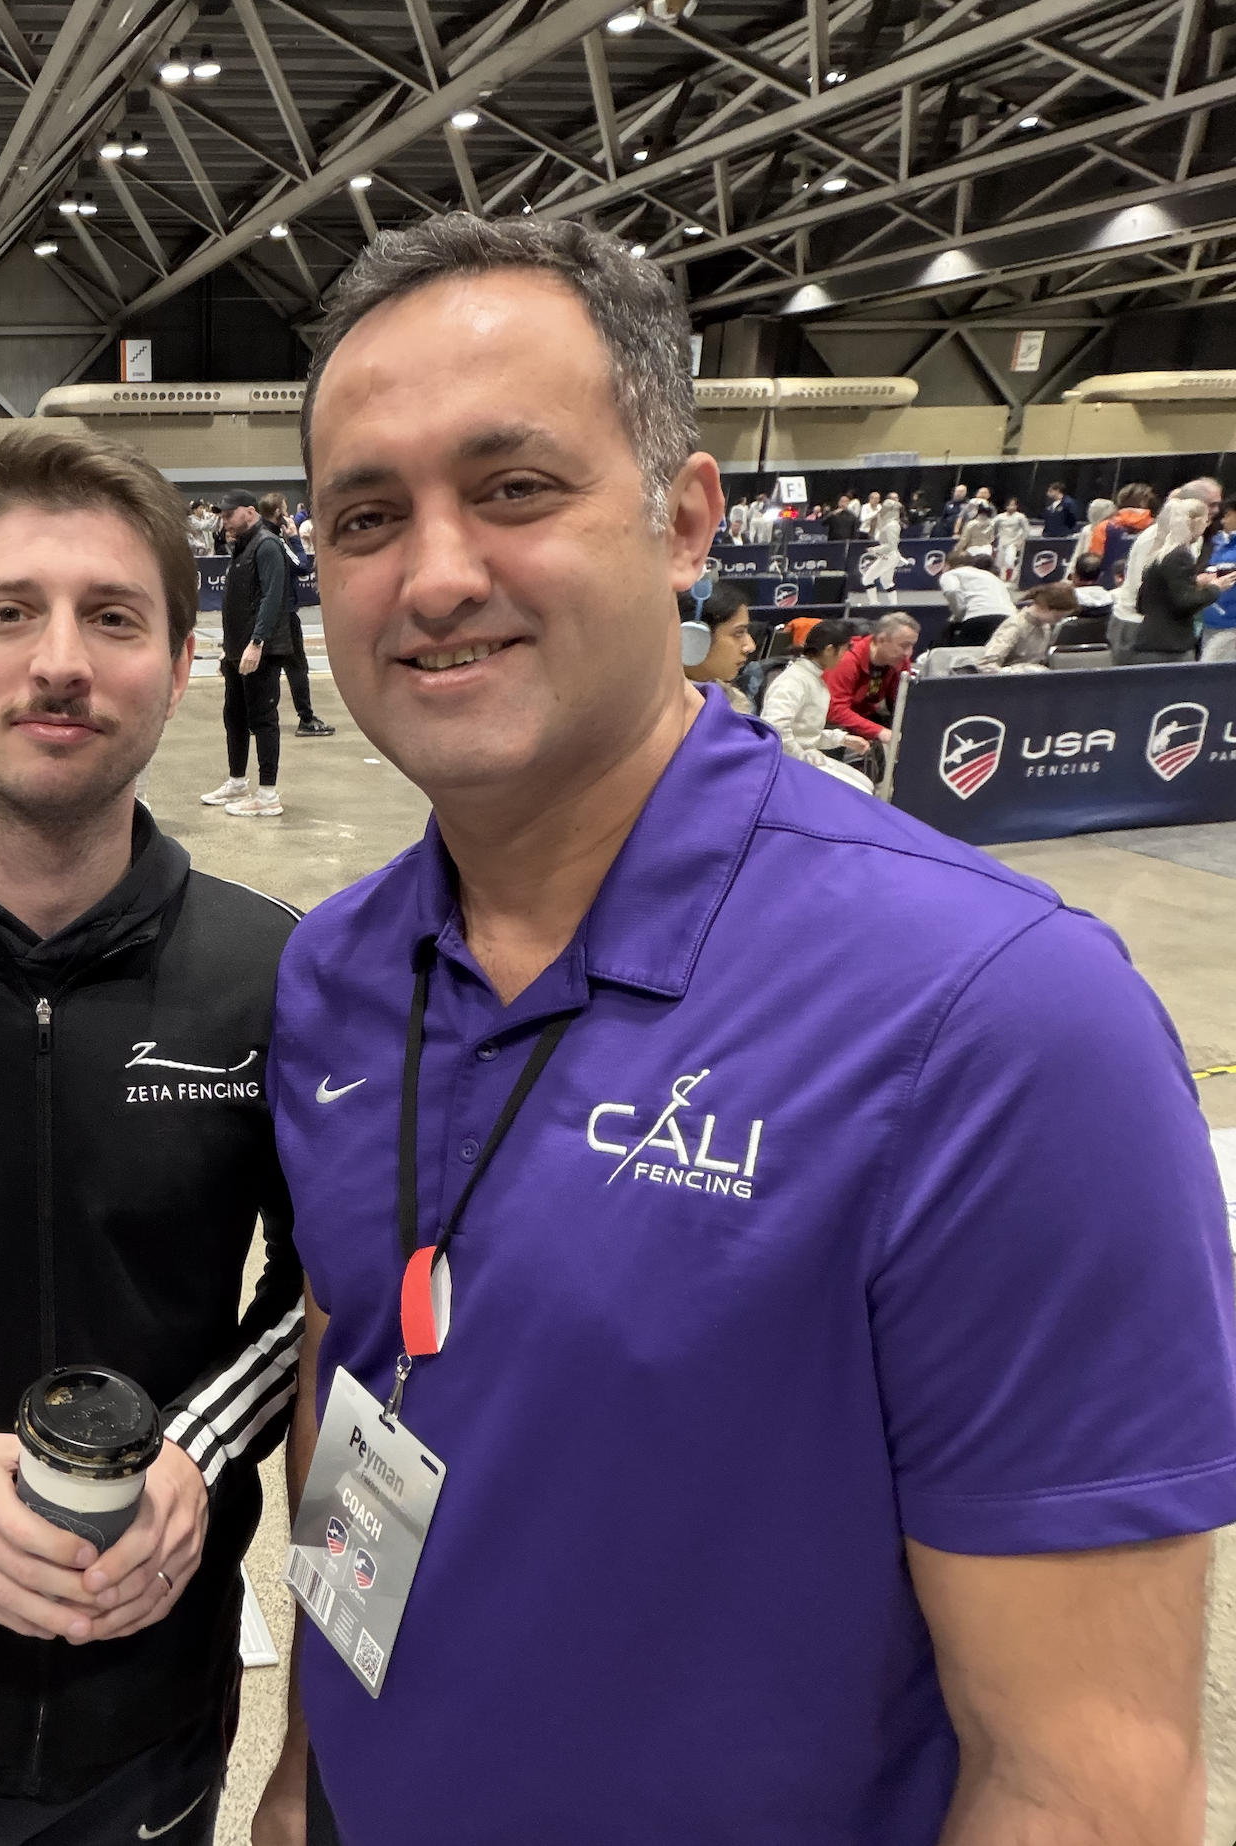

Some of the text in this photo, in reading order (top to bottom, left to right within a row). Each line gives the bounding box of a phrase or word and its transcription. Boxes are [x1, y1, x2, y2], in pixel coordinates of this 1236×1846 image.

[786, 483, 794, 498] F
[1021, 729, 1116, 759] USA
[1026, 761, 1101, 778] FENCING
[126, 1081, 260, 1103] ZETA FENCING
[587, 1098, 764, 1178] CALI
[634, 1162, 753, 1200] FENCING
[349, 1425, 405, 1498] Peyman
[342, 1487, 383, 1542] COACH
